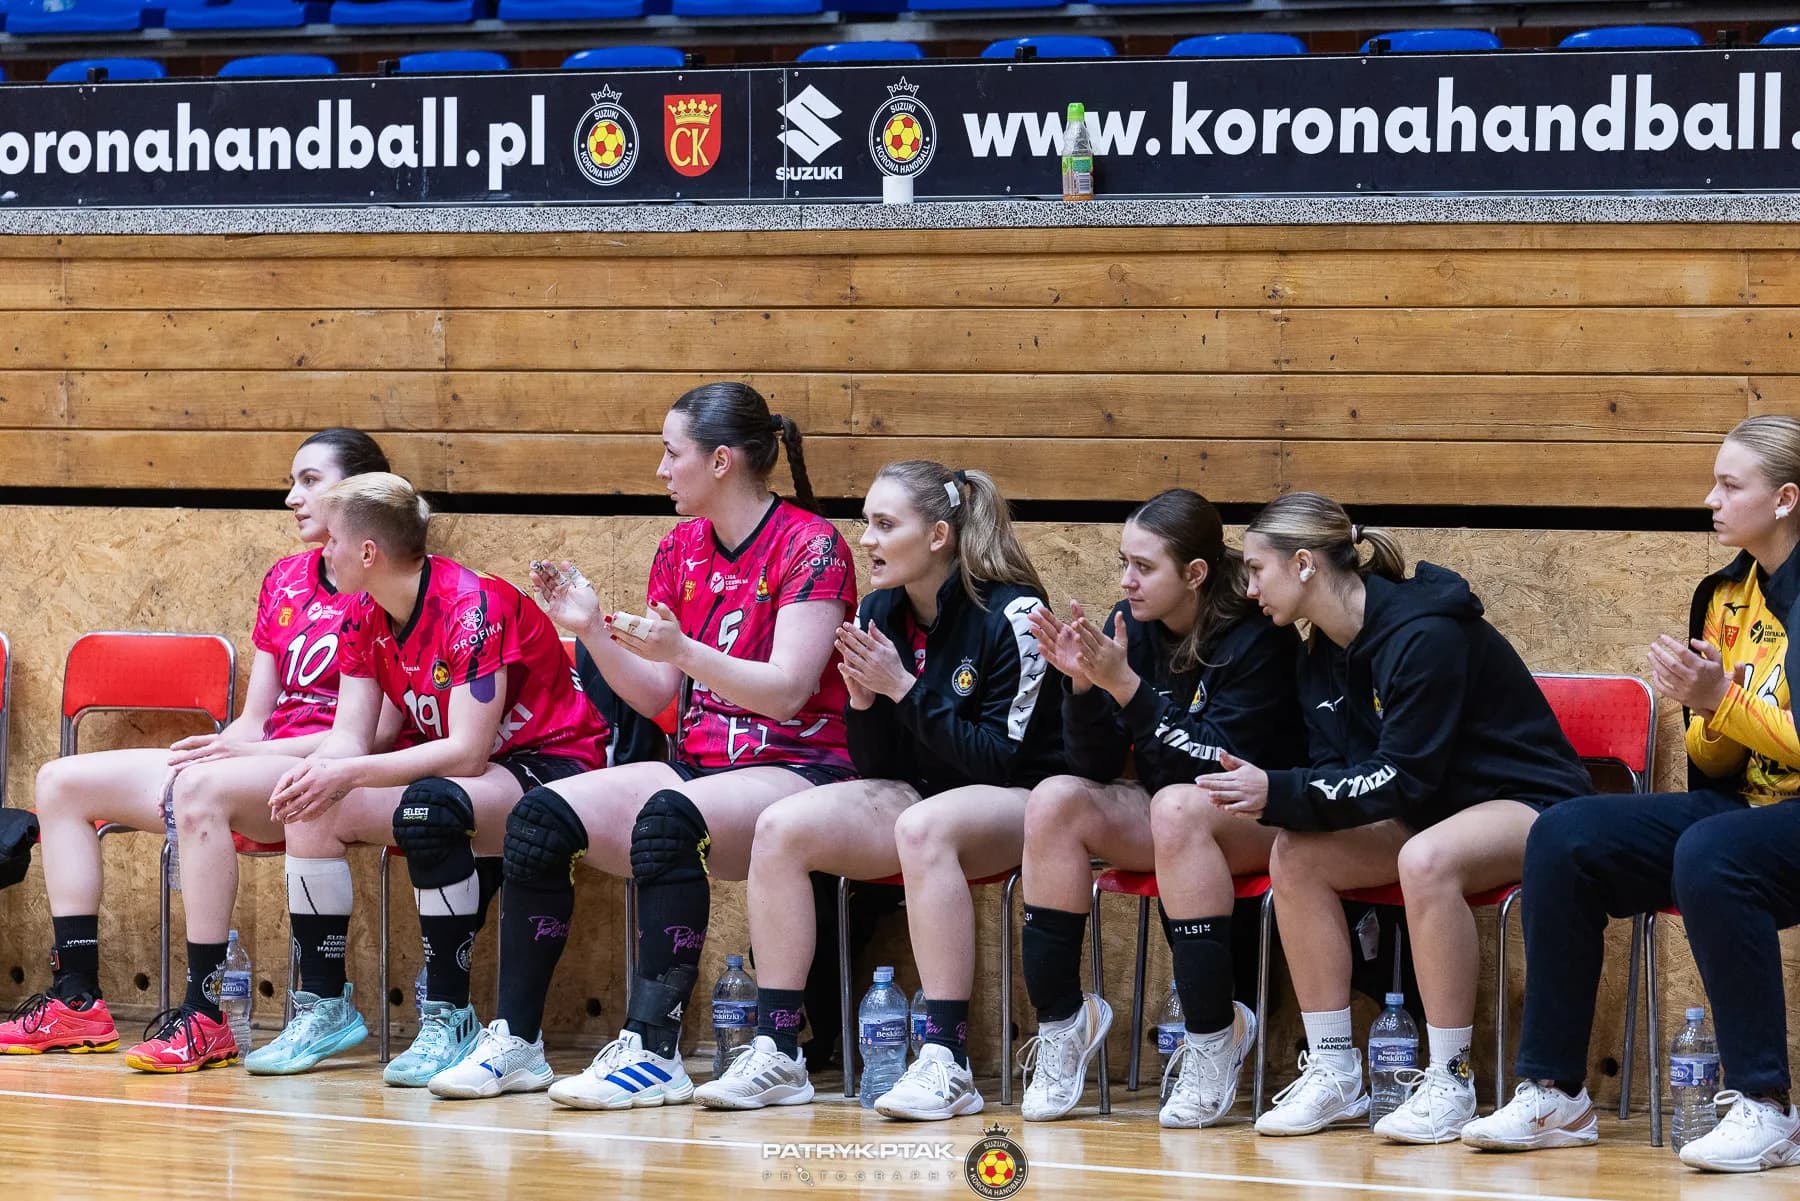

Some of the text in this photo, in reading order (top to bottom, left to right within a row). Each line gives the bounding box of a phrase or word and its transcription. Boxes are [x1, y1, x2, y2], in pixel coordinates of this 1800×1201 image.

[594, 108, 619, 121] SUZUKI
[890, 102, 917, 114] SUZUKI
[0, 94, 545, 191] oronahandball.pl
[670, 127, 710, 167] CK
[580, 150, 634, 179] KORONA HANDBALL
[875, 143, 931, 173] KORONA HANDBALL
[775, 166, 843, 181] SUZUKI
[453, 622, 503, 654] PROFIKA
[287, 632, 340, 687] 10
[403, 690, 443, 737] 19
[403, 808, 430, 817] SELECT
